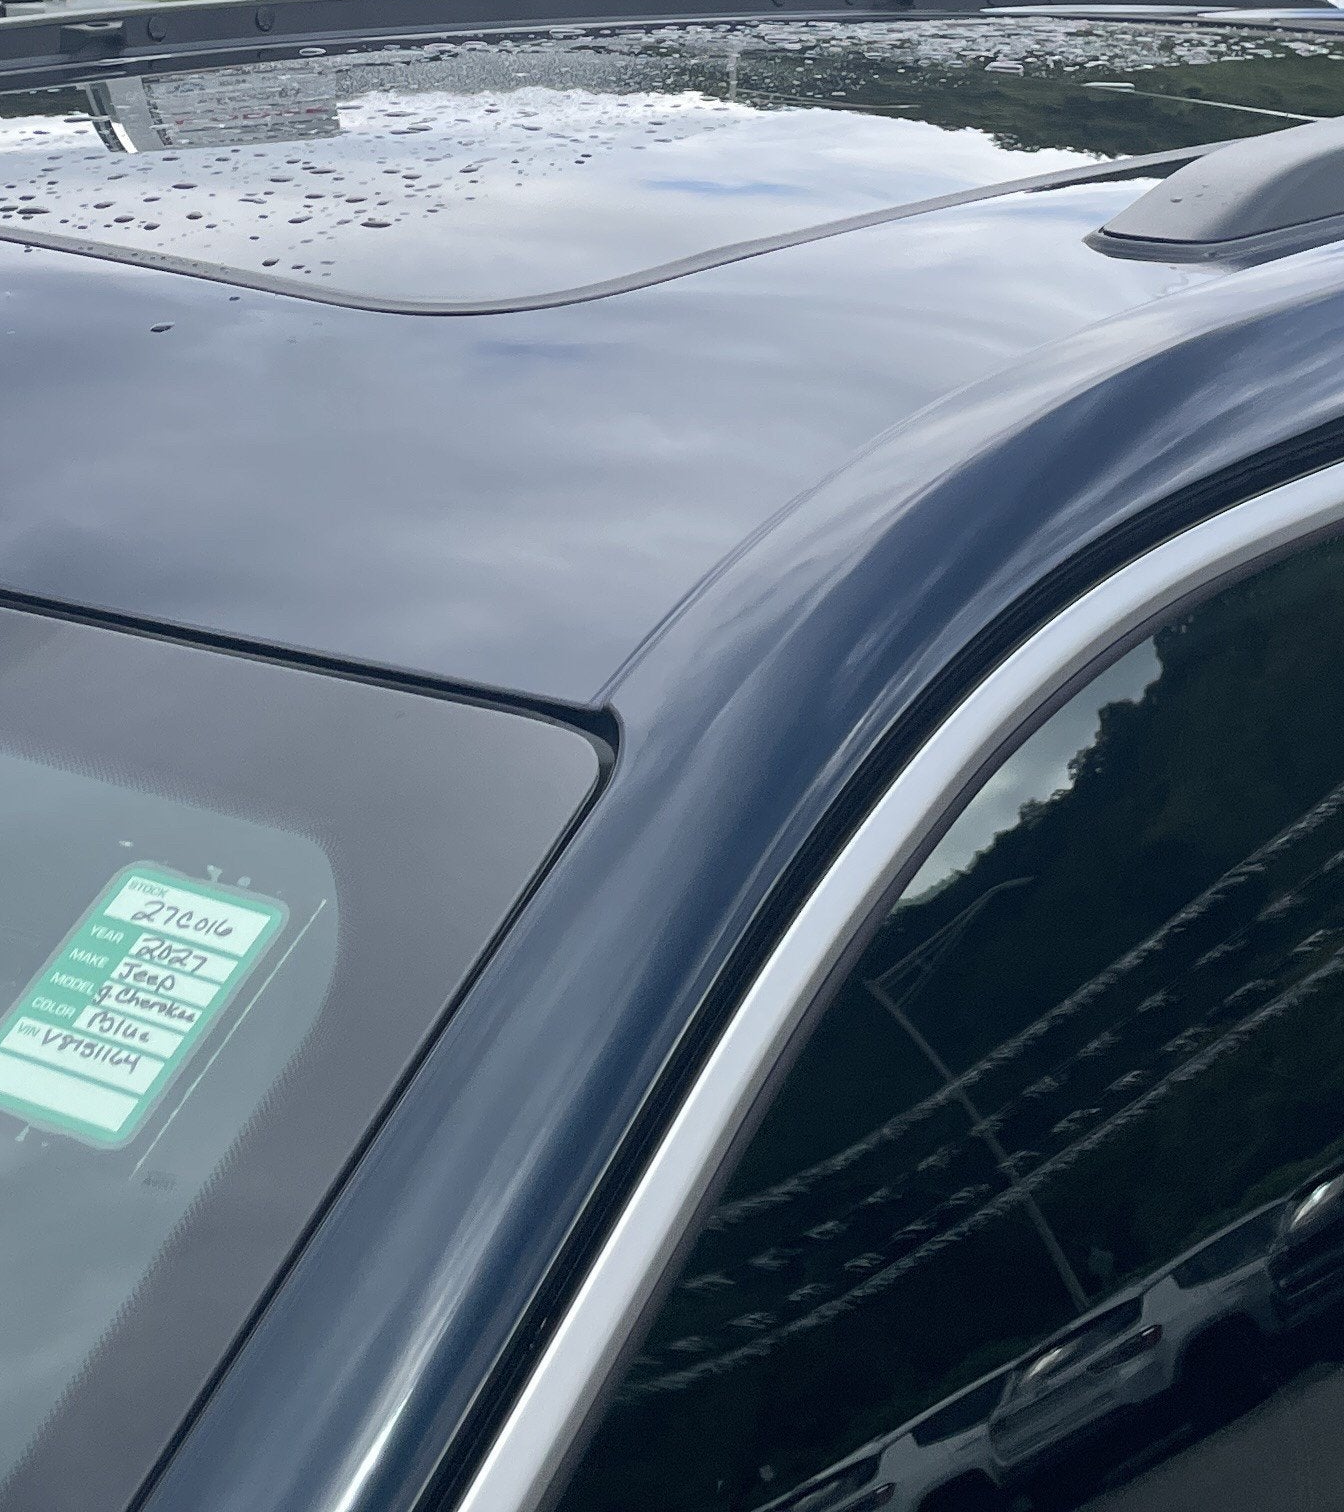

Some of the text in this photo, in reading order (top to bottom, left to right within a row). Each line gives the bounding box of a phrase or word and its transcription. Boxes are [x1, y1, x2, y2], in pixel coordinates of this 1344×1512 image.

[130, 879, 167, 898] STOCK
[90, 924, 125, 945] YEAR
[69, 948, 110, 969] MAKE
[135, 937, 208, 973] 2027
[49, 972, 96, 996] MODEL
[119, 961, 176, 994] Jeep
[31, 996, 76, 1019] COLOR
[17, 1021, 41, 1037] VIN
[86, 1010, 151, 1043] Blue
